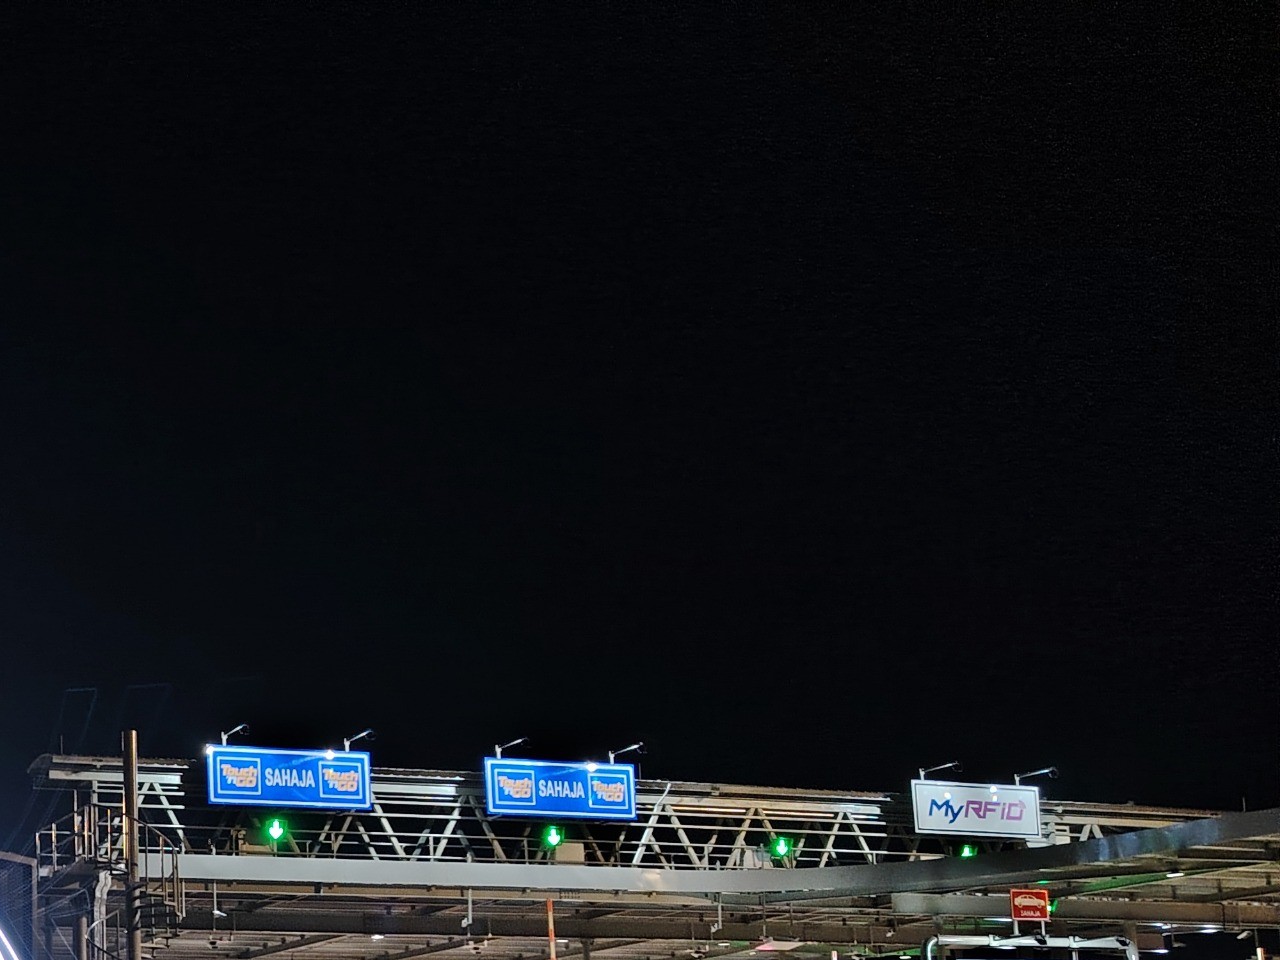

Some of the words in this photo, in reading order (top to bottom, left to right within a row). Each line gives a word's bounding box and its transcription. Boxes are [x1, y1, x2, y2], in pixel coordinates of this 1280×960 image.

[221, 764, 258, 777] Touch
[265, 768, 315, 788] SAHAJA
[322, 768, 359, 780] Touch
[539, 779, 585, 798] SAHAJA
